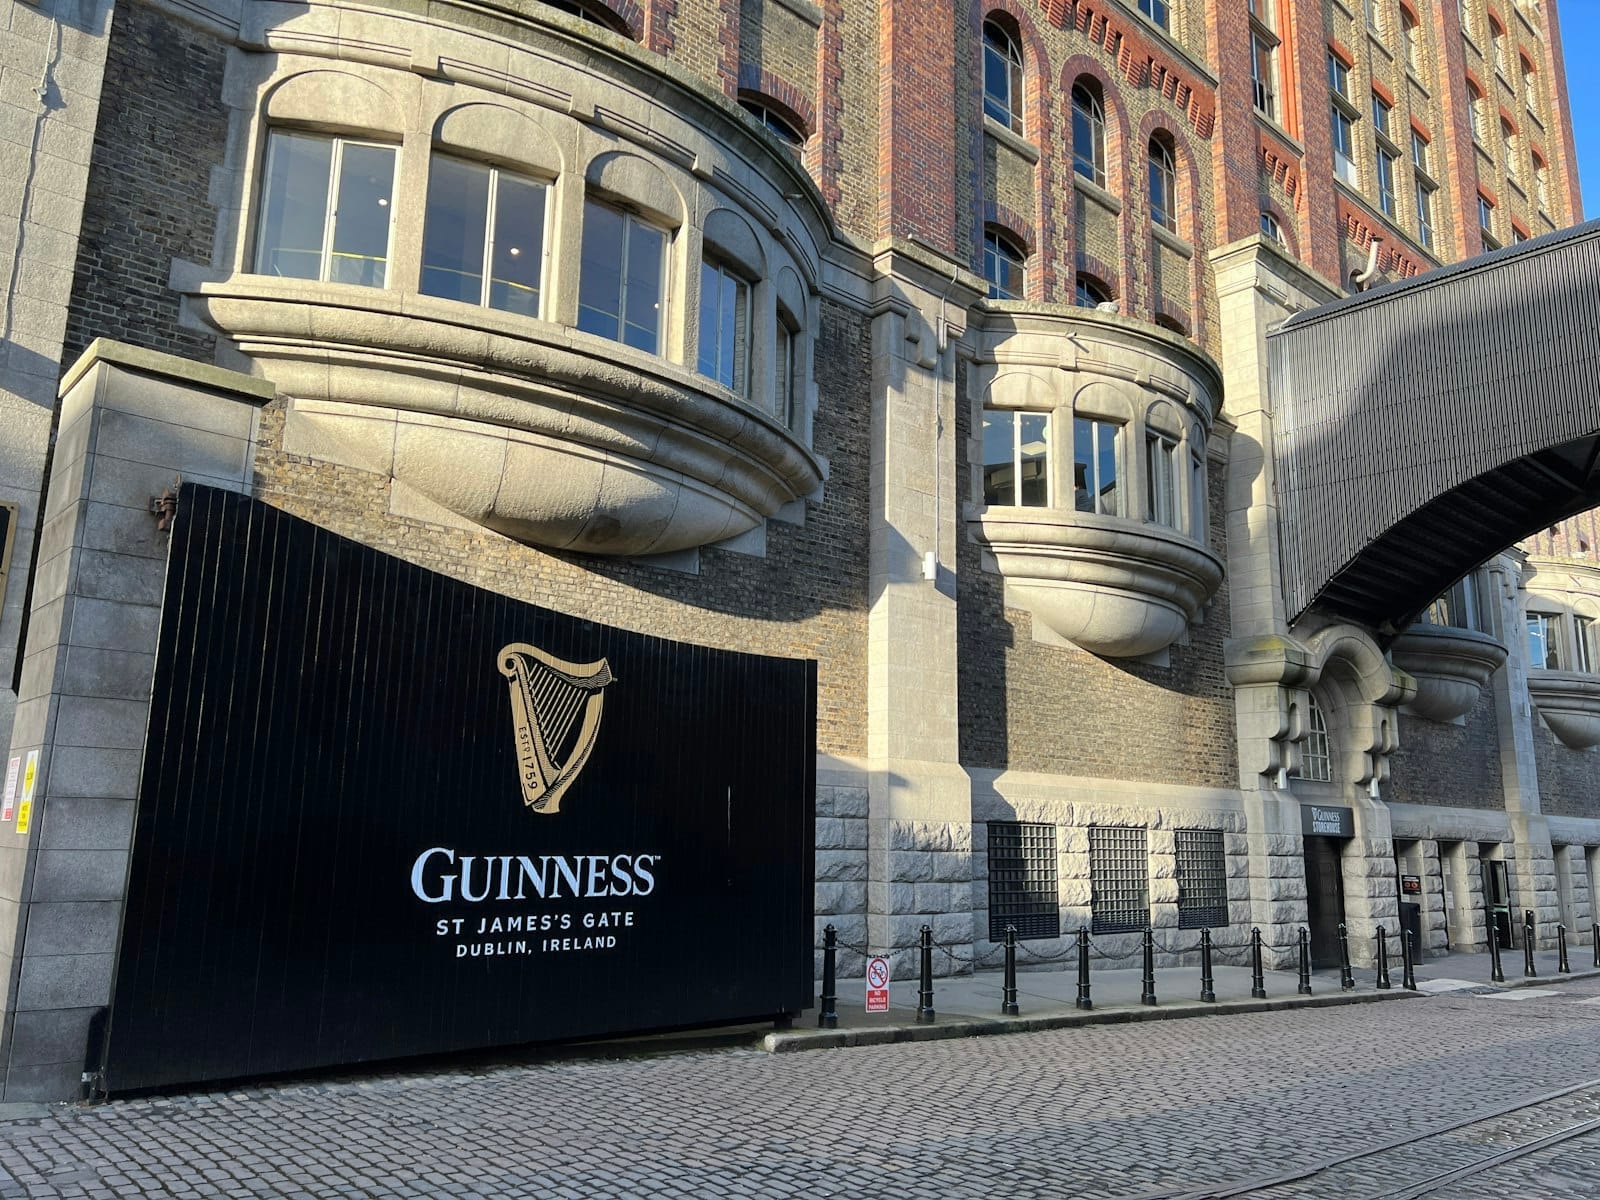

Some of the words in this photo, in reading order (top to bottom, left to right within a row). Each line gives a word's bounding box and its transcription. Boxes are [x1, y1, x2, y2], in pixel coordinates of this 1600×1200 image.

[522, 755, 538, 790] 1759
[1312, 821, 1340, 833] STOREHOUSE
[1317, 809, 1340, 821] GUINNESS
[410, 846, 656, 903] GUINNESS
[436, 918, 466, 936] ST
[477, 913, 572, 935] JAMES'S
[582, 911, 635, 928] GATE
[456, 940, 533, 958] DUBLIN,
[542, 935, 617, 953] IRELAND
